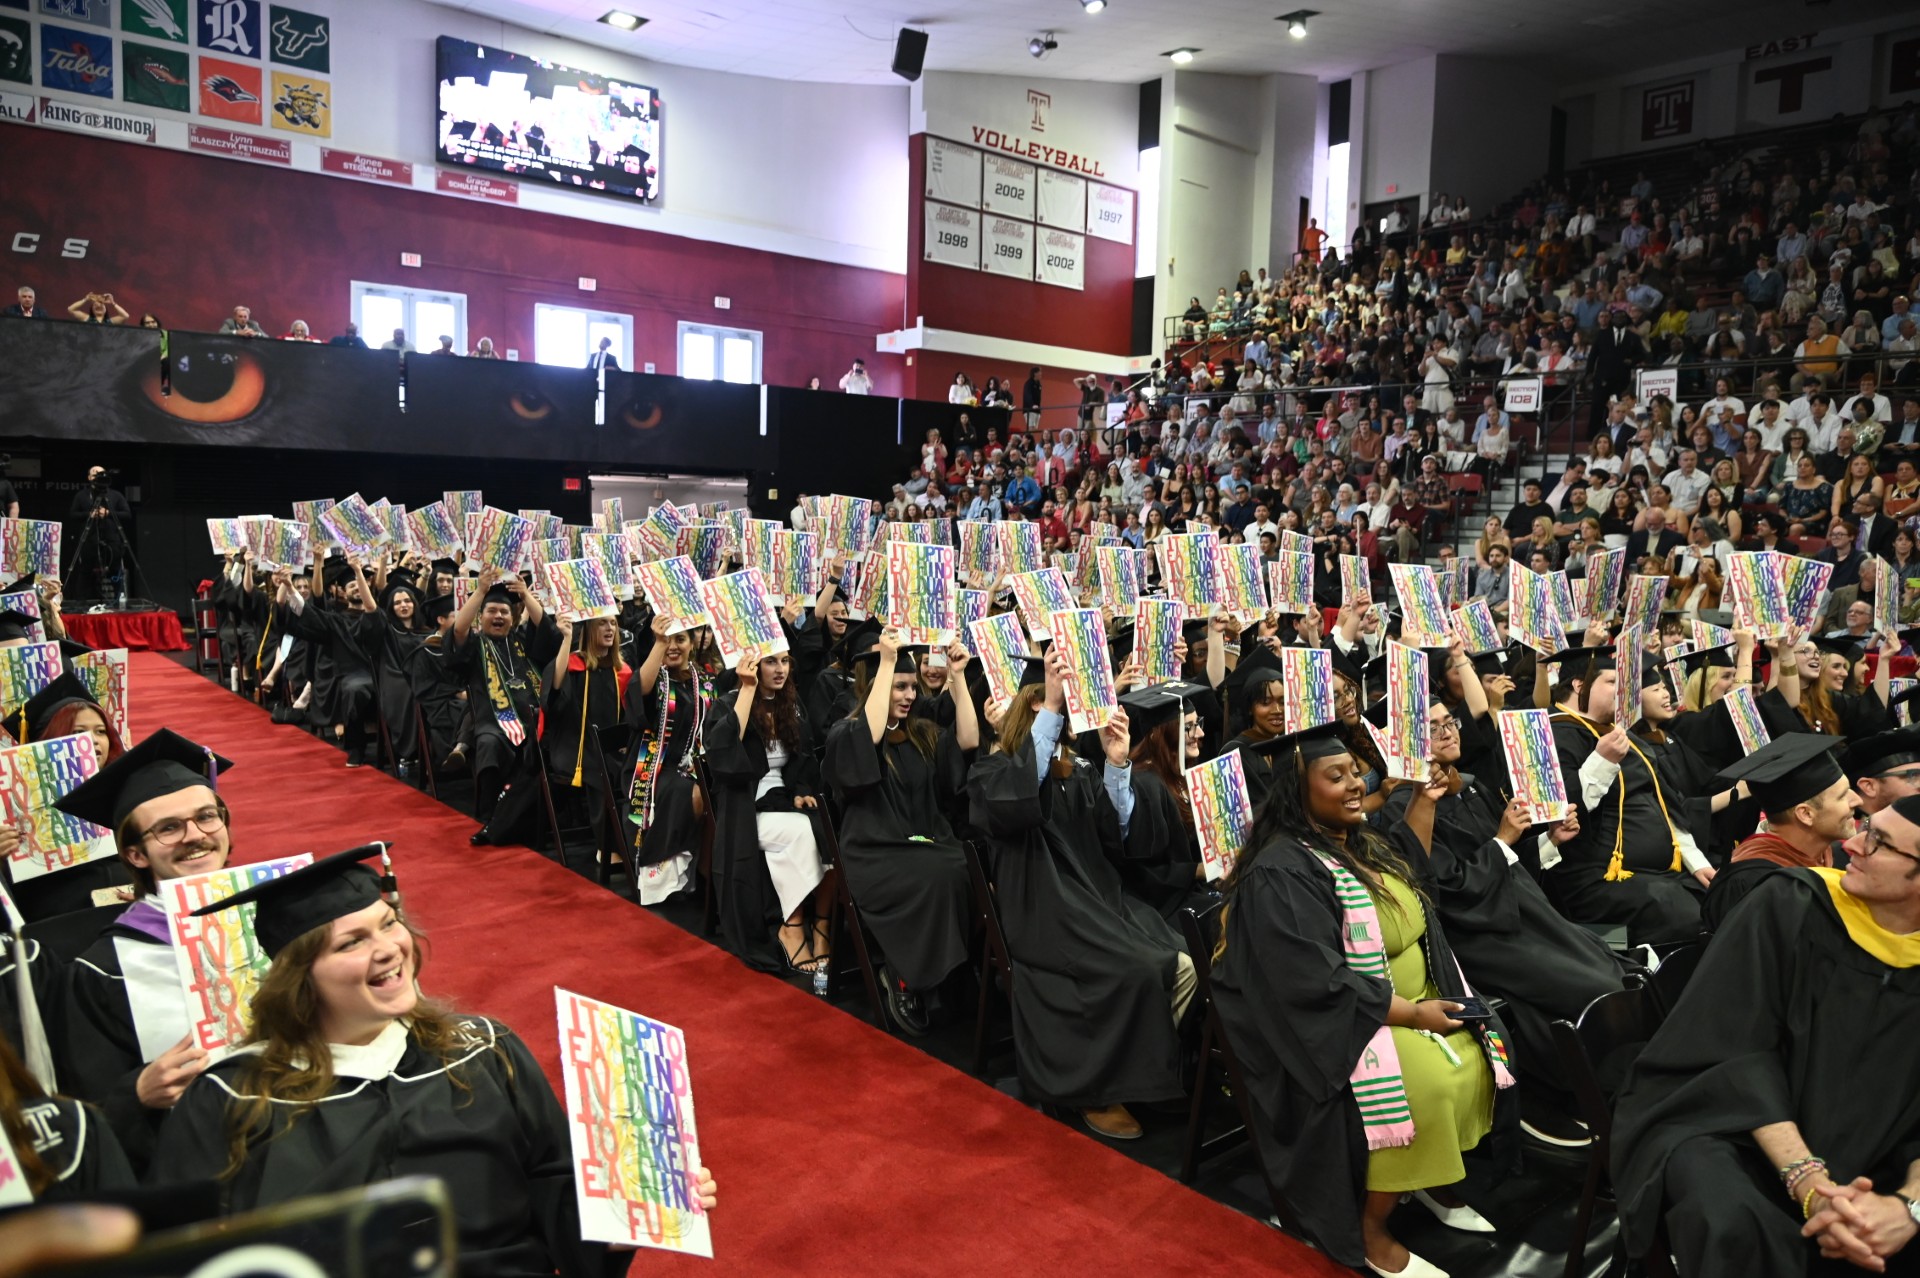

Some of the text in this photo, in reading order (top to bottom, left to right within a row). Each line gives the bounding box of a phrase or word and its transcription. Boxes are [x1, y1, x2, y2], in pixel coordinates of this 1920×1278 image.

[1745, 32, 1818, 60] EAST
[45, 47, 111, 79] Tulsa
[45, 105, 152, 135] RING OF HONOR
[191, 135, 237, 149] BLASZCZYK
[238, 143, 289, 158] PETRUZZELLI
[230, 133, 253, 145] Lynn
[972, 126, 1105, 177] VOLLEYBALL
[995, 182, 1025, 201] 2002
[1098, 208, 1122, 224] 1997
[937, 231, 968, 249] 1998
[994, 243, 1023, 260] 1999
[1047, 254, 1075, 271] 2002
[1641, 377, 1676, 386] SECTION
[1510, 395, 1532, 404] 102
[1645, 388, 1671, 398] 103
